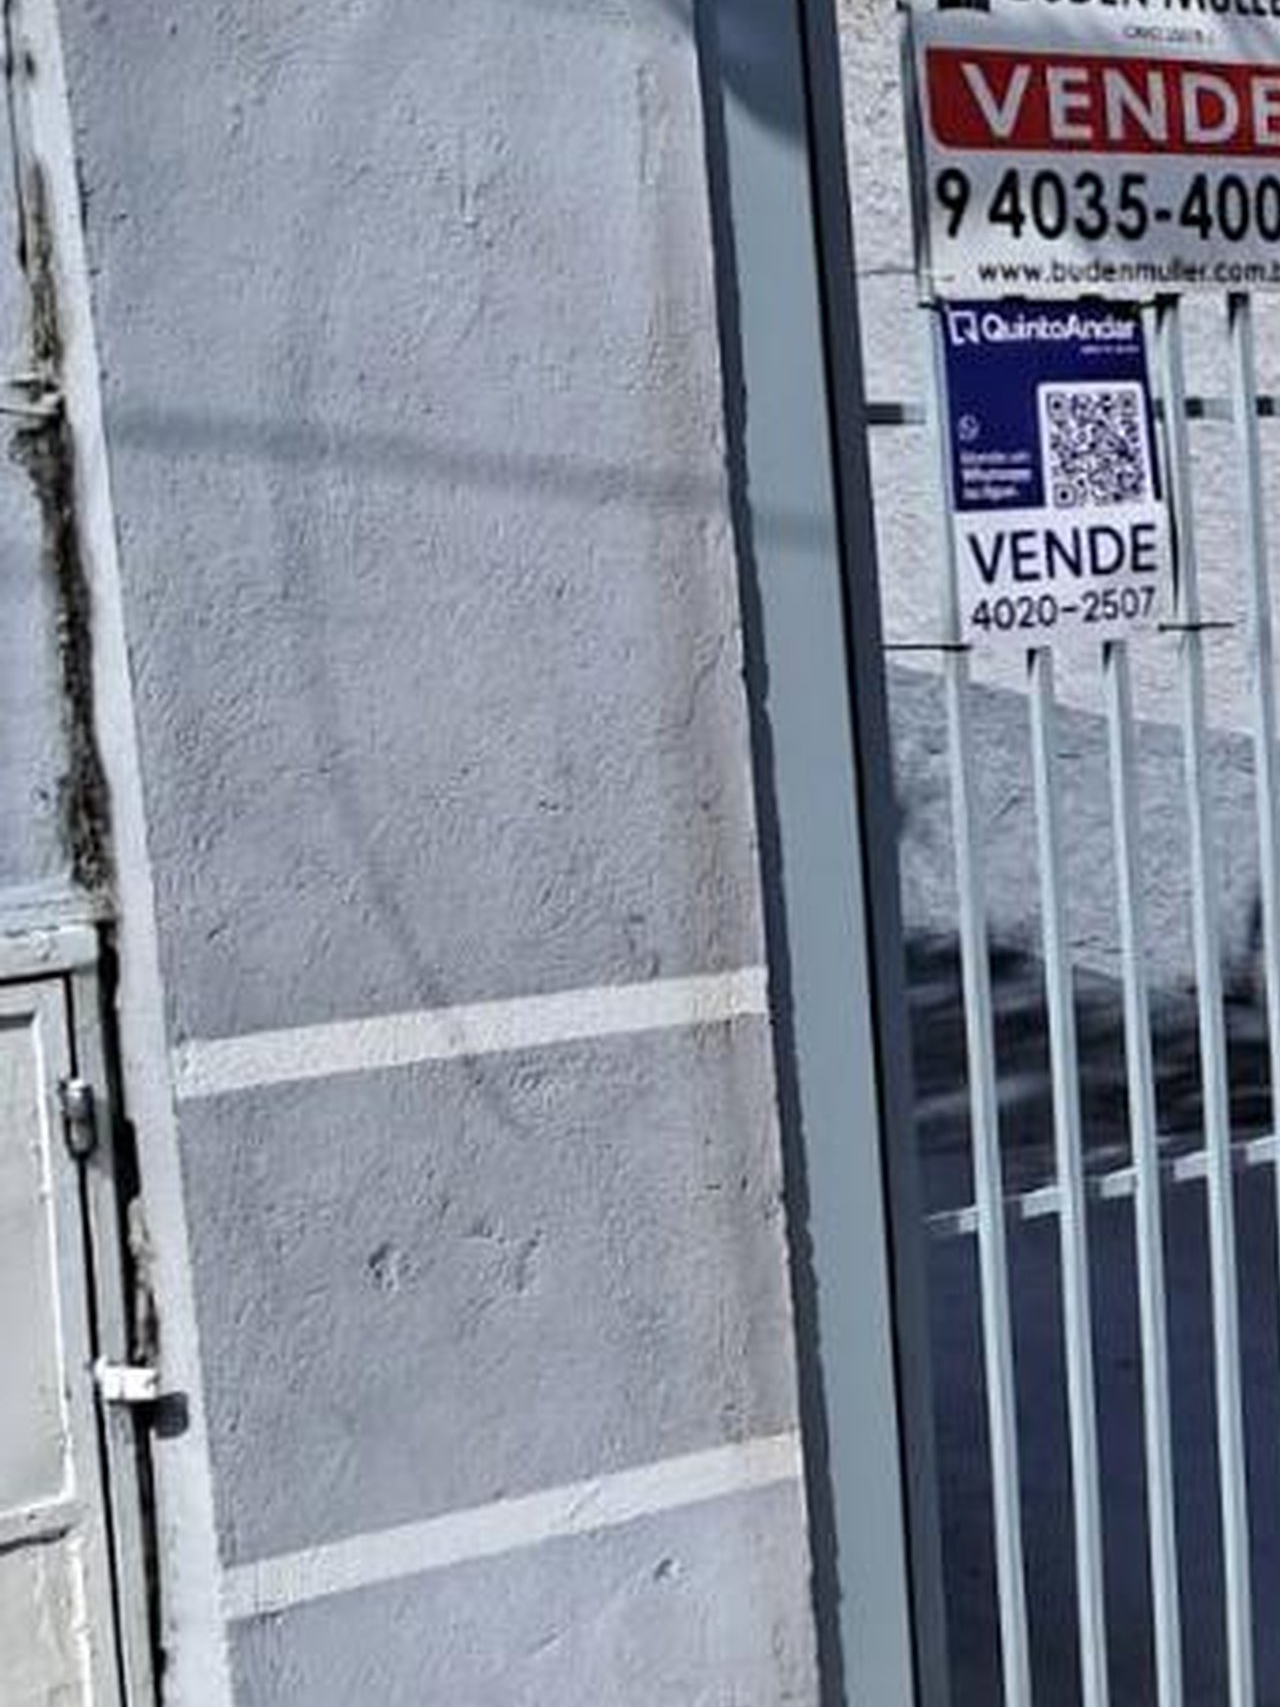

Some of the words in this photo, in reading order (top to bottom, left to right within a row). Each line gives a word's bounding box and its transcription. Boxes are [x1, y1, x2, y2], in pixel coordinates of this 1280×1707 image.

[935, 168, 969, 238] 9
[967, 524, 1158, 584] VENDE
[971, 587, 1157, 631] 4020-2507
